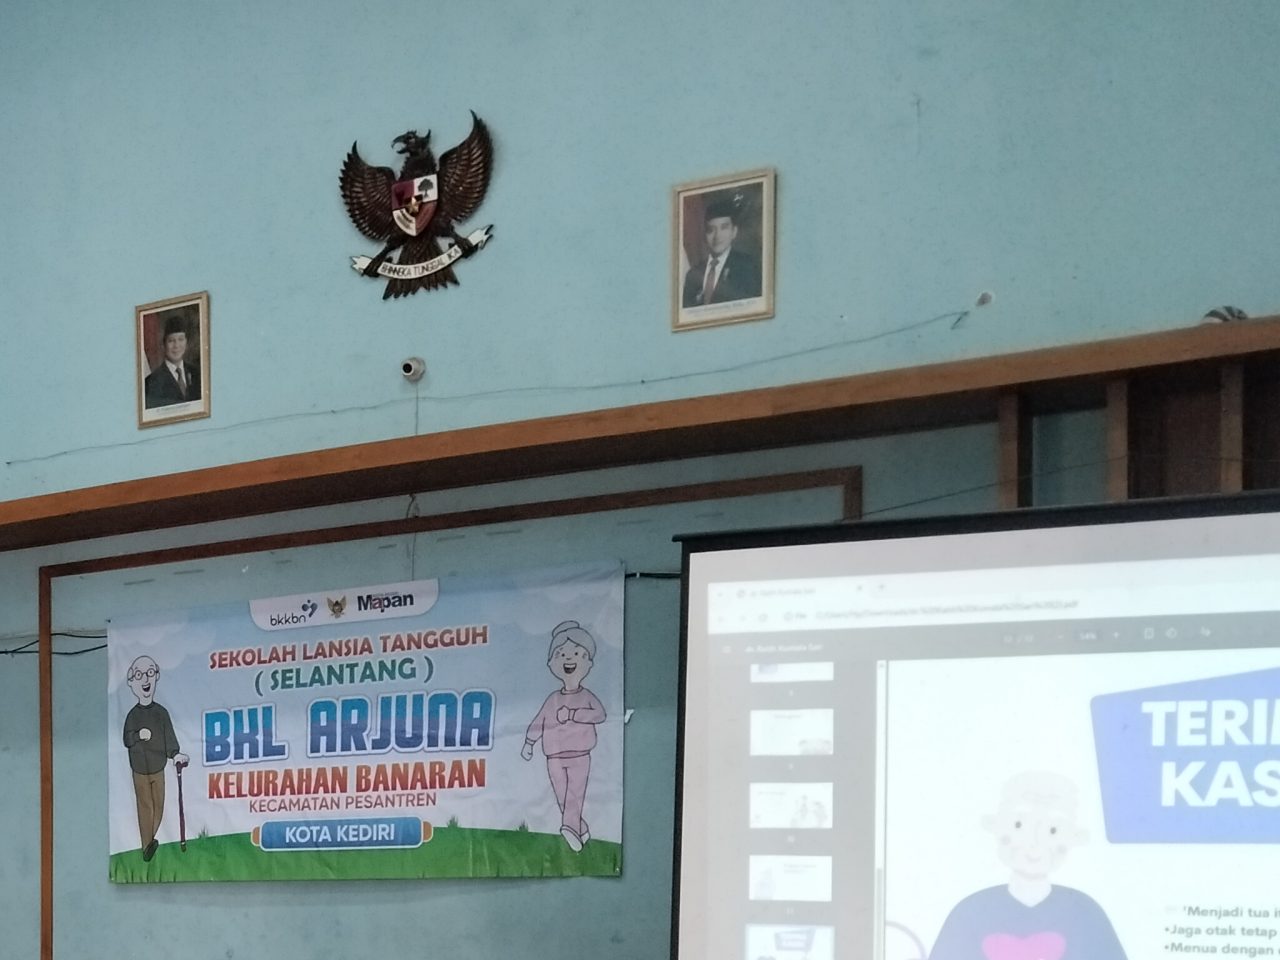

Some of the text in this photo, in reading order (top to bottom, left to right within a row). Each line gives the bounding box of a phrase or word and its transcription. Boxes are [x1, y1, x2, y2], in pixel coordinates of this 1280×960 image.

[357, 593, 414, 613] Mapan
[270, 612, 306, 626] bkkbn
[209, 625, 488, 670] SEKOLAH LANSIA TANGGUH
[270, 657, 417, 691] SELANTANG
[308, 690, 493, 755] ARJUNA
[1141, 698, 1280, 747] TERI
[208, 758, 486, 800] KELURAHAN BANARAN
[1161, 760, 1280, 807] KAS
[249, 792, 437, 813] KECAMATAN PESANTREN
[285, 823, 395, 843] KOTA KEDIRI
[1247, 907, 1270, 918] tua
[1205, 924, 1236, 936] otak
[1240, 926, 1278, 941] tetap
[1221, 943, 1274, 959] dengan
